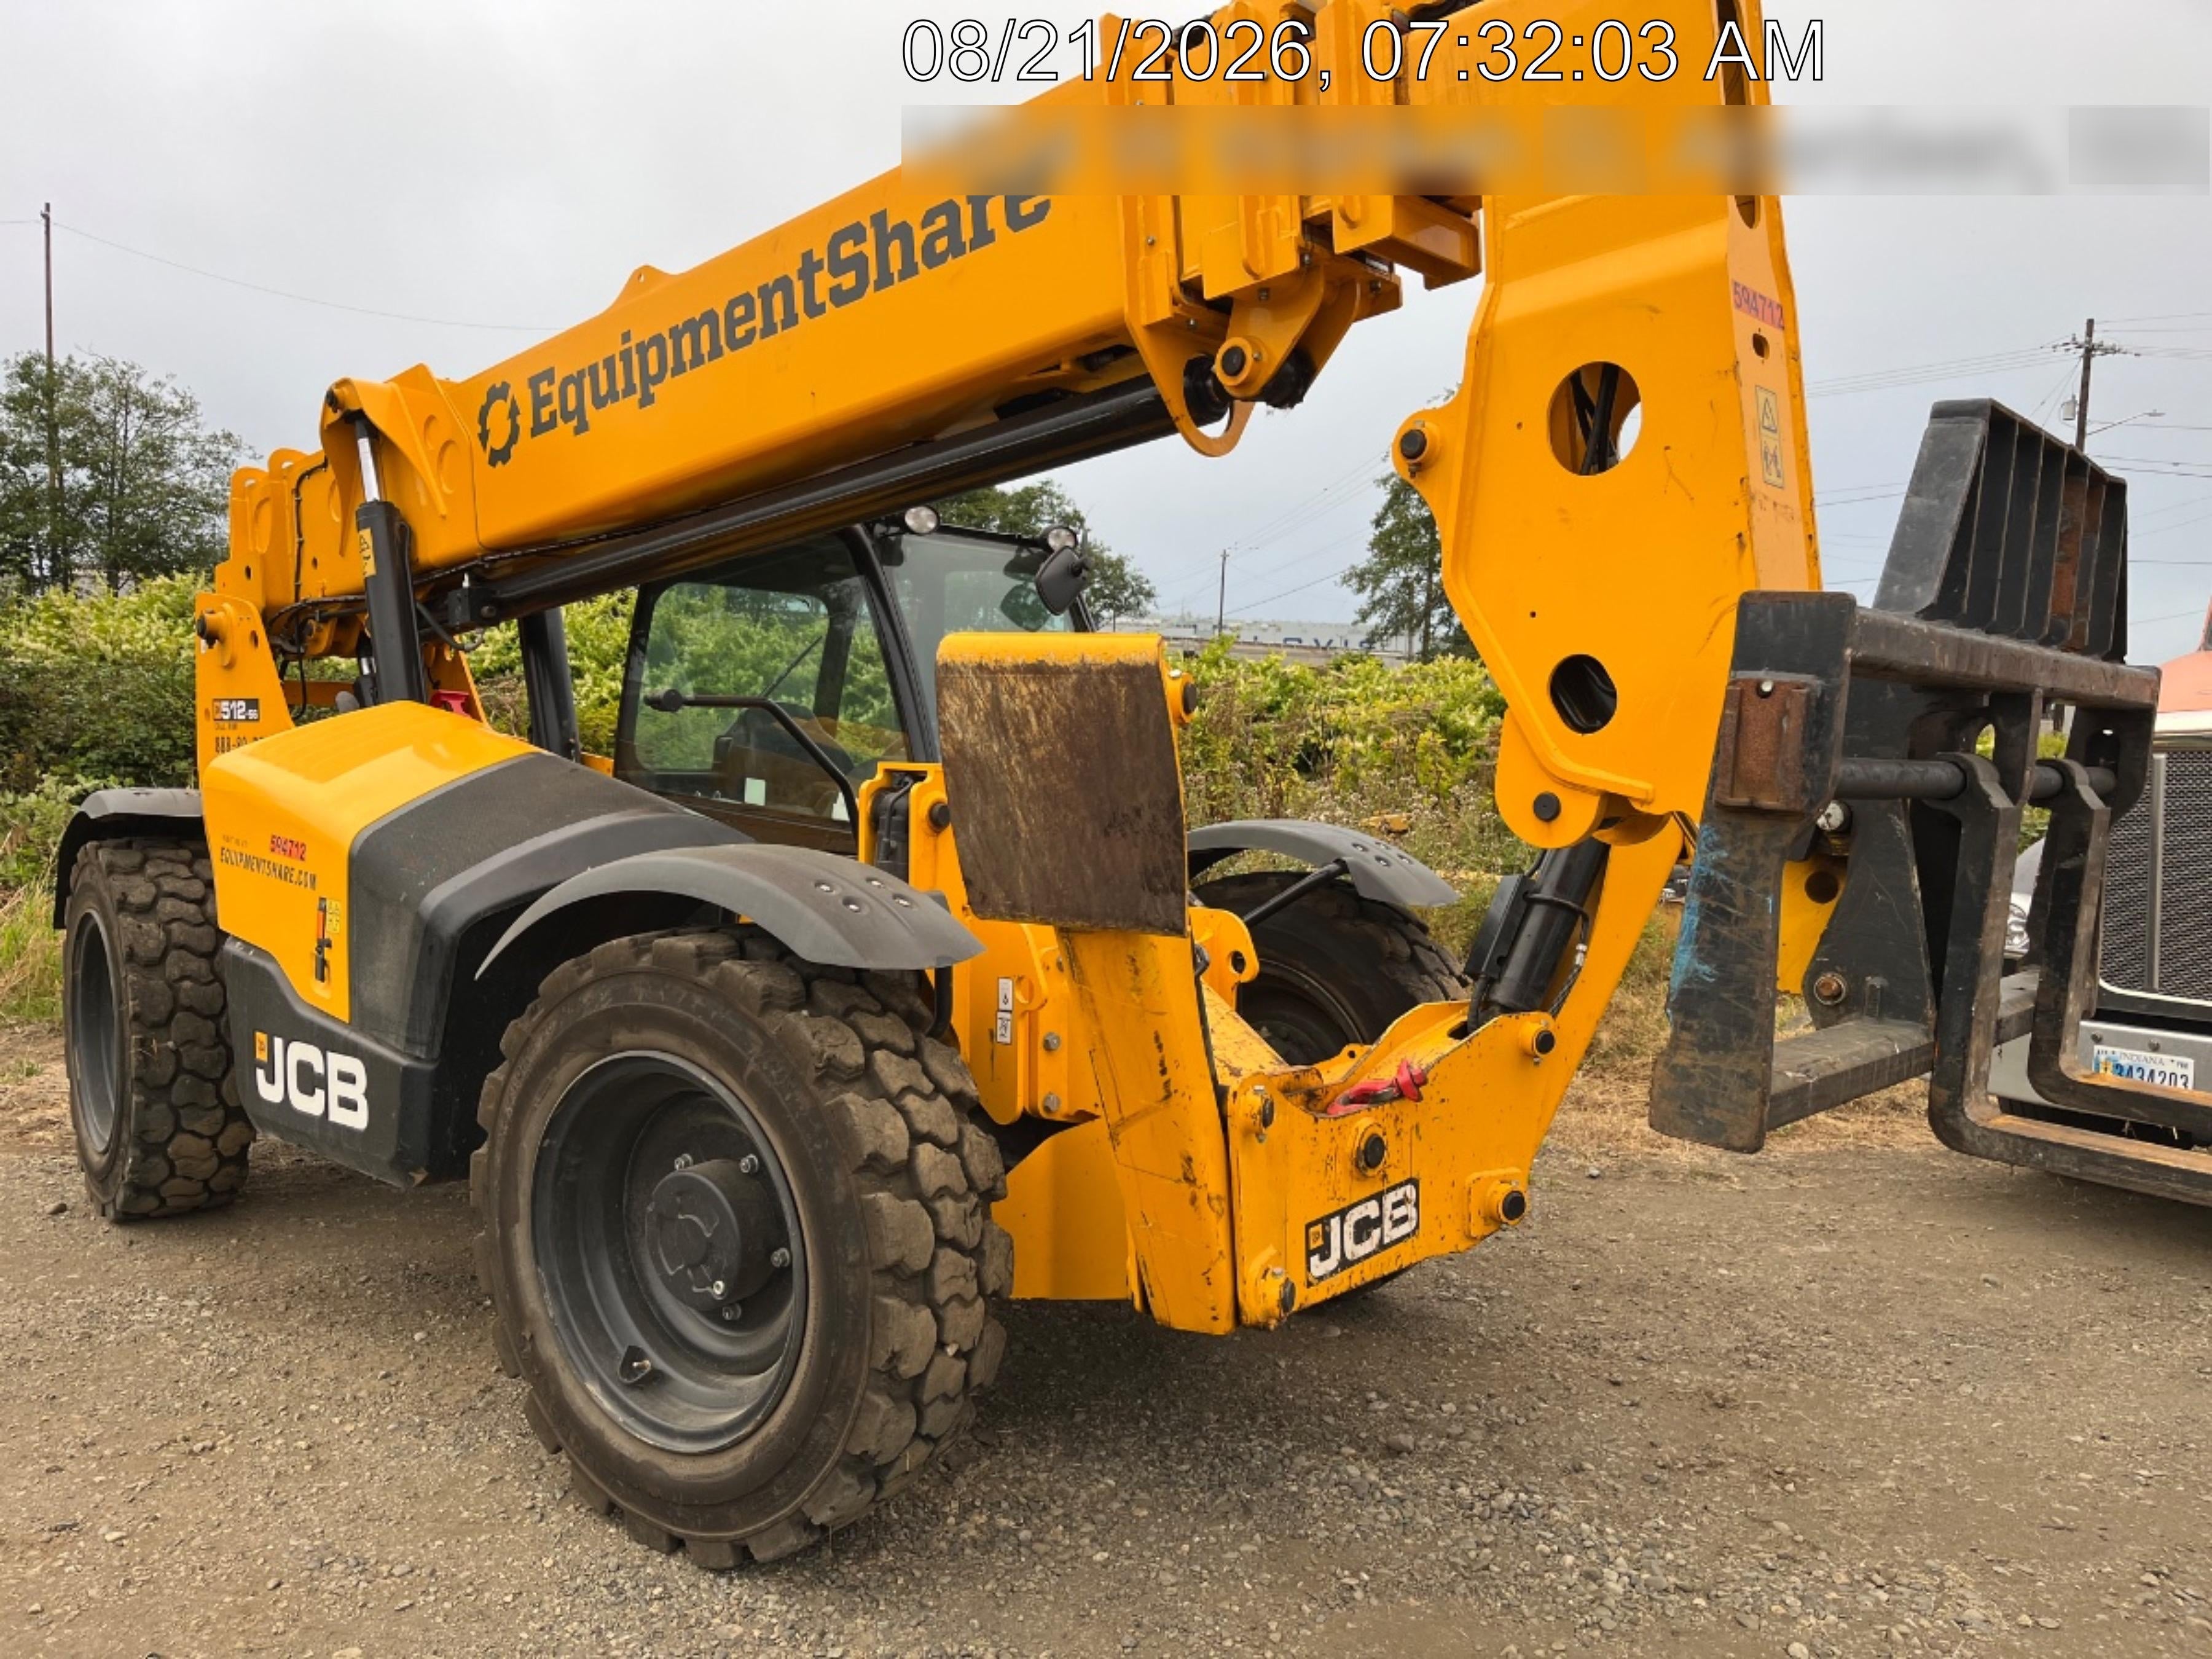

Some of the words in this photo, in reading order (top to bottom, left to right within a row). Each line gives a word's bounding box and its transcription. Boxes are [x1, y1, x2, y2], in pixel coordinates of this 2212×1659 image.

[528, 194, 1050, 436] EquipmentShare
[270, 834, 307, 861] 594712
[255, 1036, 369, 1132] JCB
[2120, 1051, 2165, 1066] INDIANA
[1309, 1183, 1418, 1277] JCB
